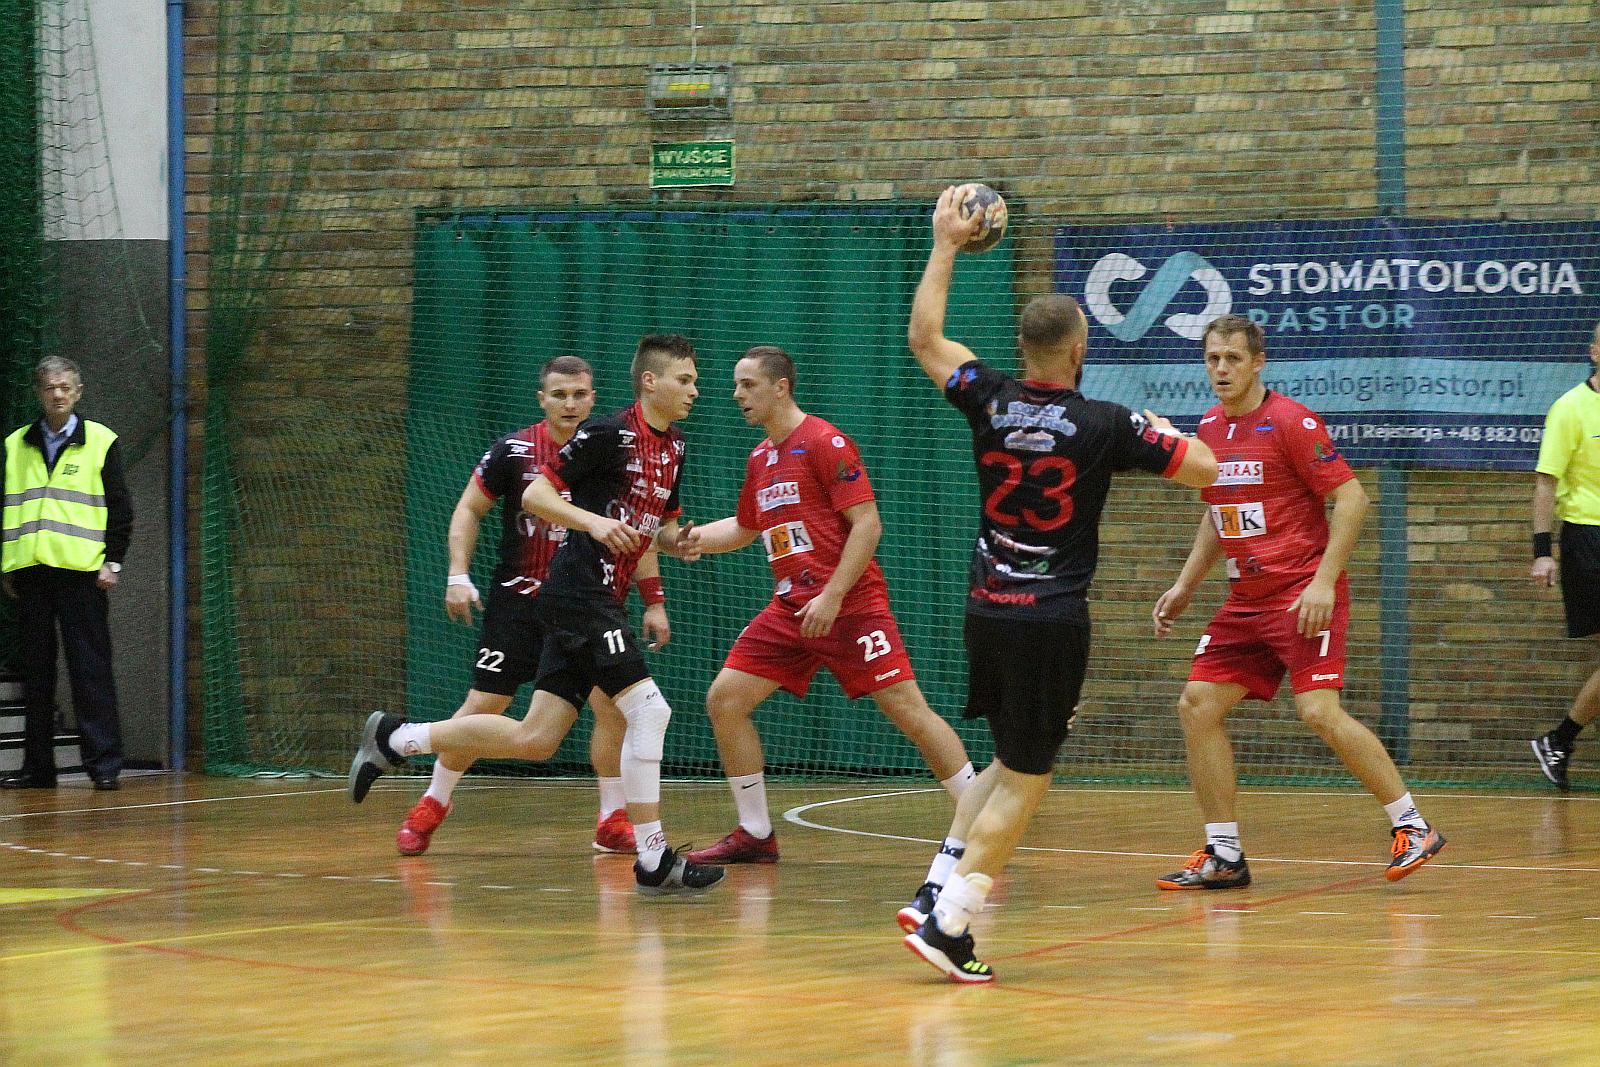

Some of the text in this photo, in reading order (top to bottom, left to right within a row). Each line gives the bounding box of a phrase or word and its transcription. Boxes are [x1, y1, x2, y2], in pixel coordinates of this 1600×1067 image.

[1248, 258, 1583, 295] STOMATOLOGIA
[1248, 303, 1415, 332] PASTOR
[1141, 369, 1526, 402] www.matologia-pastor.pl
[1520, 427, 1548, 443] 02
[980, 451, 1077, 531] 23
[603, 628, 626, 655] 11
[856, 629, 892, 663] 23
[1315, 629, 1331, 657] 7
[475, 647, 505, 673] 22
